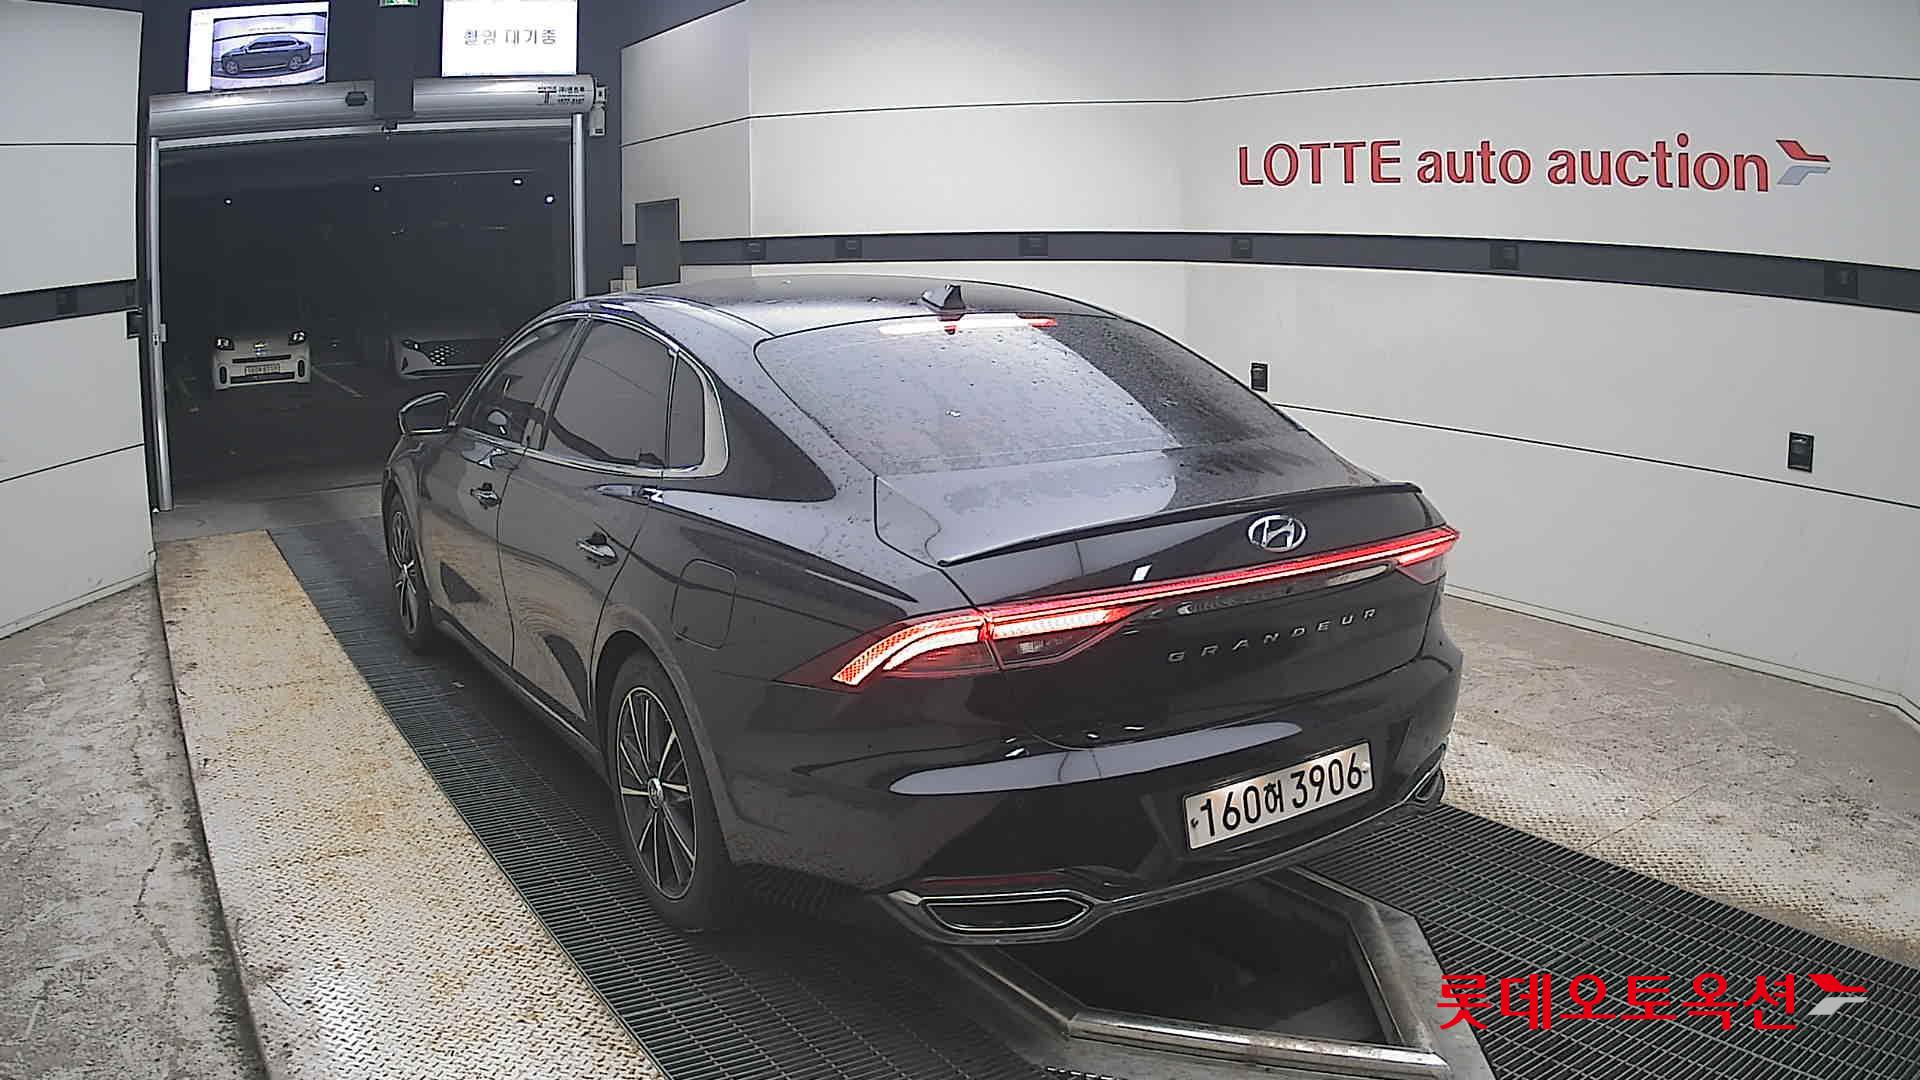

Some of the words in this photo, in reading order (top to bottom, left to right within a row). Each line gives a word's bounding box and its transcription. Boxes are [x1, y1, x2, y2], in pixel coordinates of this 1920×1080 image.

[1238, 140, 1401, 187] LOTTE
[1416, 138, 1532, 185] auto
[1547, 132, 1770, 193] auction
[1168, 608, 1377, 662] GRANDEUR
